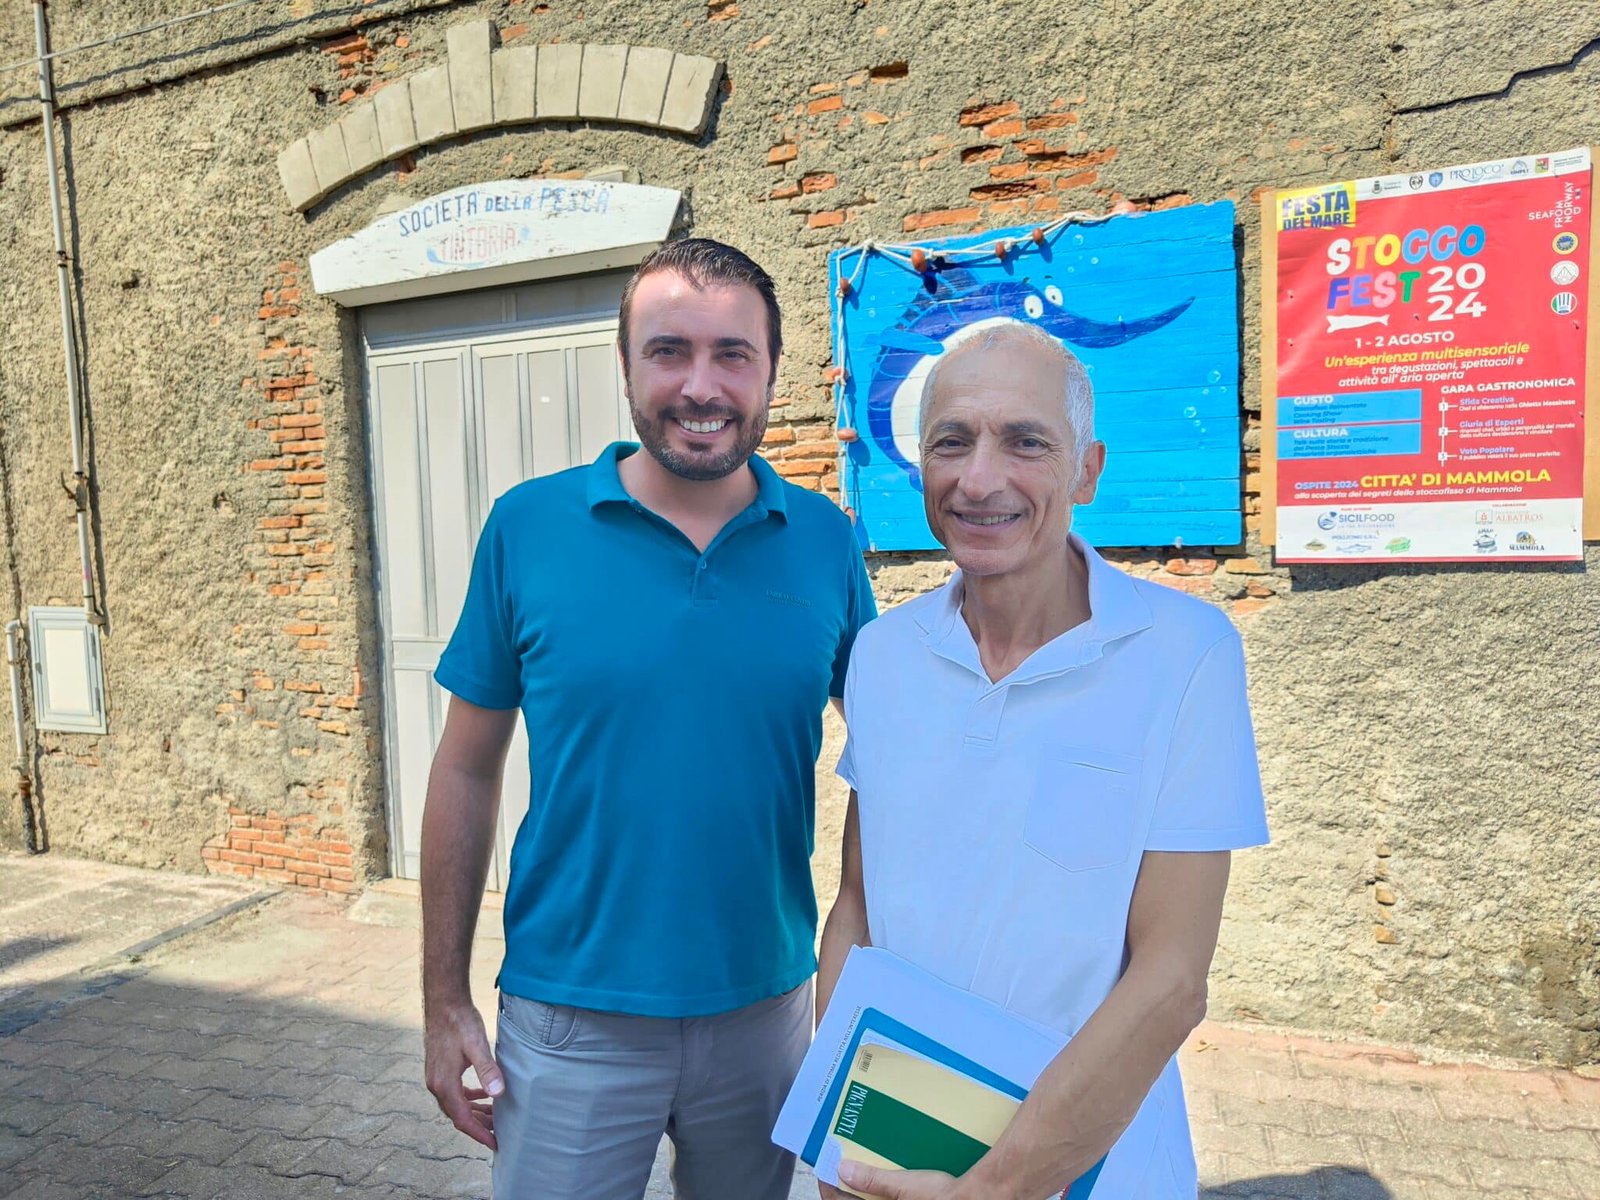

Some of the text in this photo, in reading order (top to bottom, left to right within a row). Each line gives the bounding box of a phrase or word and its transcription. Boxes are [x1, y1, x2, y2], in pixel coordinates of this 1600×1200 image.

[485, 194, 533, 212] DELLA
[539, 187, 609, 213] PESCA
[1283, 190, 1350, 217] FESTA
[1564, 182, 1574, 223] NORWAY
[1283, 211, 1350, 230] DEL MARE
[1528, 206, 1582, 221] SEAFOOD
[1554, 200, 1564, 228] FROM
[1326, 224, 1486, 275] STOCCO
[1327, 270, 1422, 310] FEST
[1355, 338, 1362, 348] 1
[1375, 336, 1385, 347] 2
[1388, 331, 1455, 346] AGOSTO
[1325, 341, 1530, 368] Un'esperienza multisensoriale
[1372, 355, 1524, 376] tra degustazioni, spettacoli e
[1338, 375, 1378, 387] attività
[1400, 371, 1422, 383] aria
[1425, 370, 1464, 383] aperta
[1441, 377, 1576, 394] GARA GASTRONOMICA
[1294, 395, 1334, 405] GUSTO
[1460, 420, 1483, 428] Giuria
[1495, 418, 1524, 427] Esperti
[1294, 428, 1348, 438] CULTURA
[1479, 446, 1514, 455] Popolare
[1295, 481, 1331, 490] OSPITE
[1334, 481, 1359, 489] 2024
[1422, 473, 1441, 486] DI
[1446, 469, 1551, 485] MAMMOLA
[1311, 491, 1347, 499] scoperta
[1363, 489, 1392, 497] segreti
[1394, 488, 1414, 496] dello
[1416, 487, 1464, 496] stoccafisso
[1465, 485, 1475, 494] di
[1476, 485, 1523, 494] Mammola
[1339, 513, 1394, 523] SICILFOOD
[1496, 513, 1543, 521] ALBATROS
[817, 1084, 827, 1102] PERIZIA
